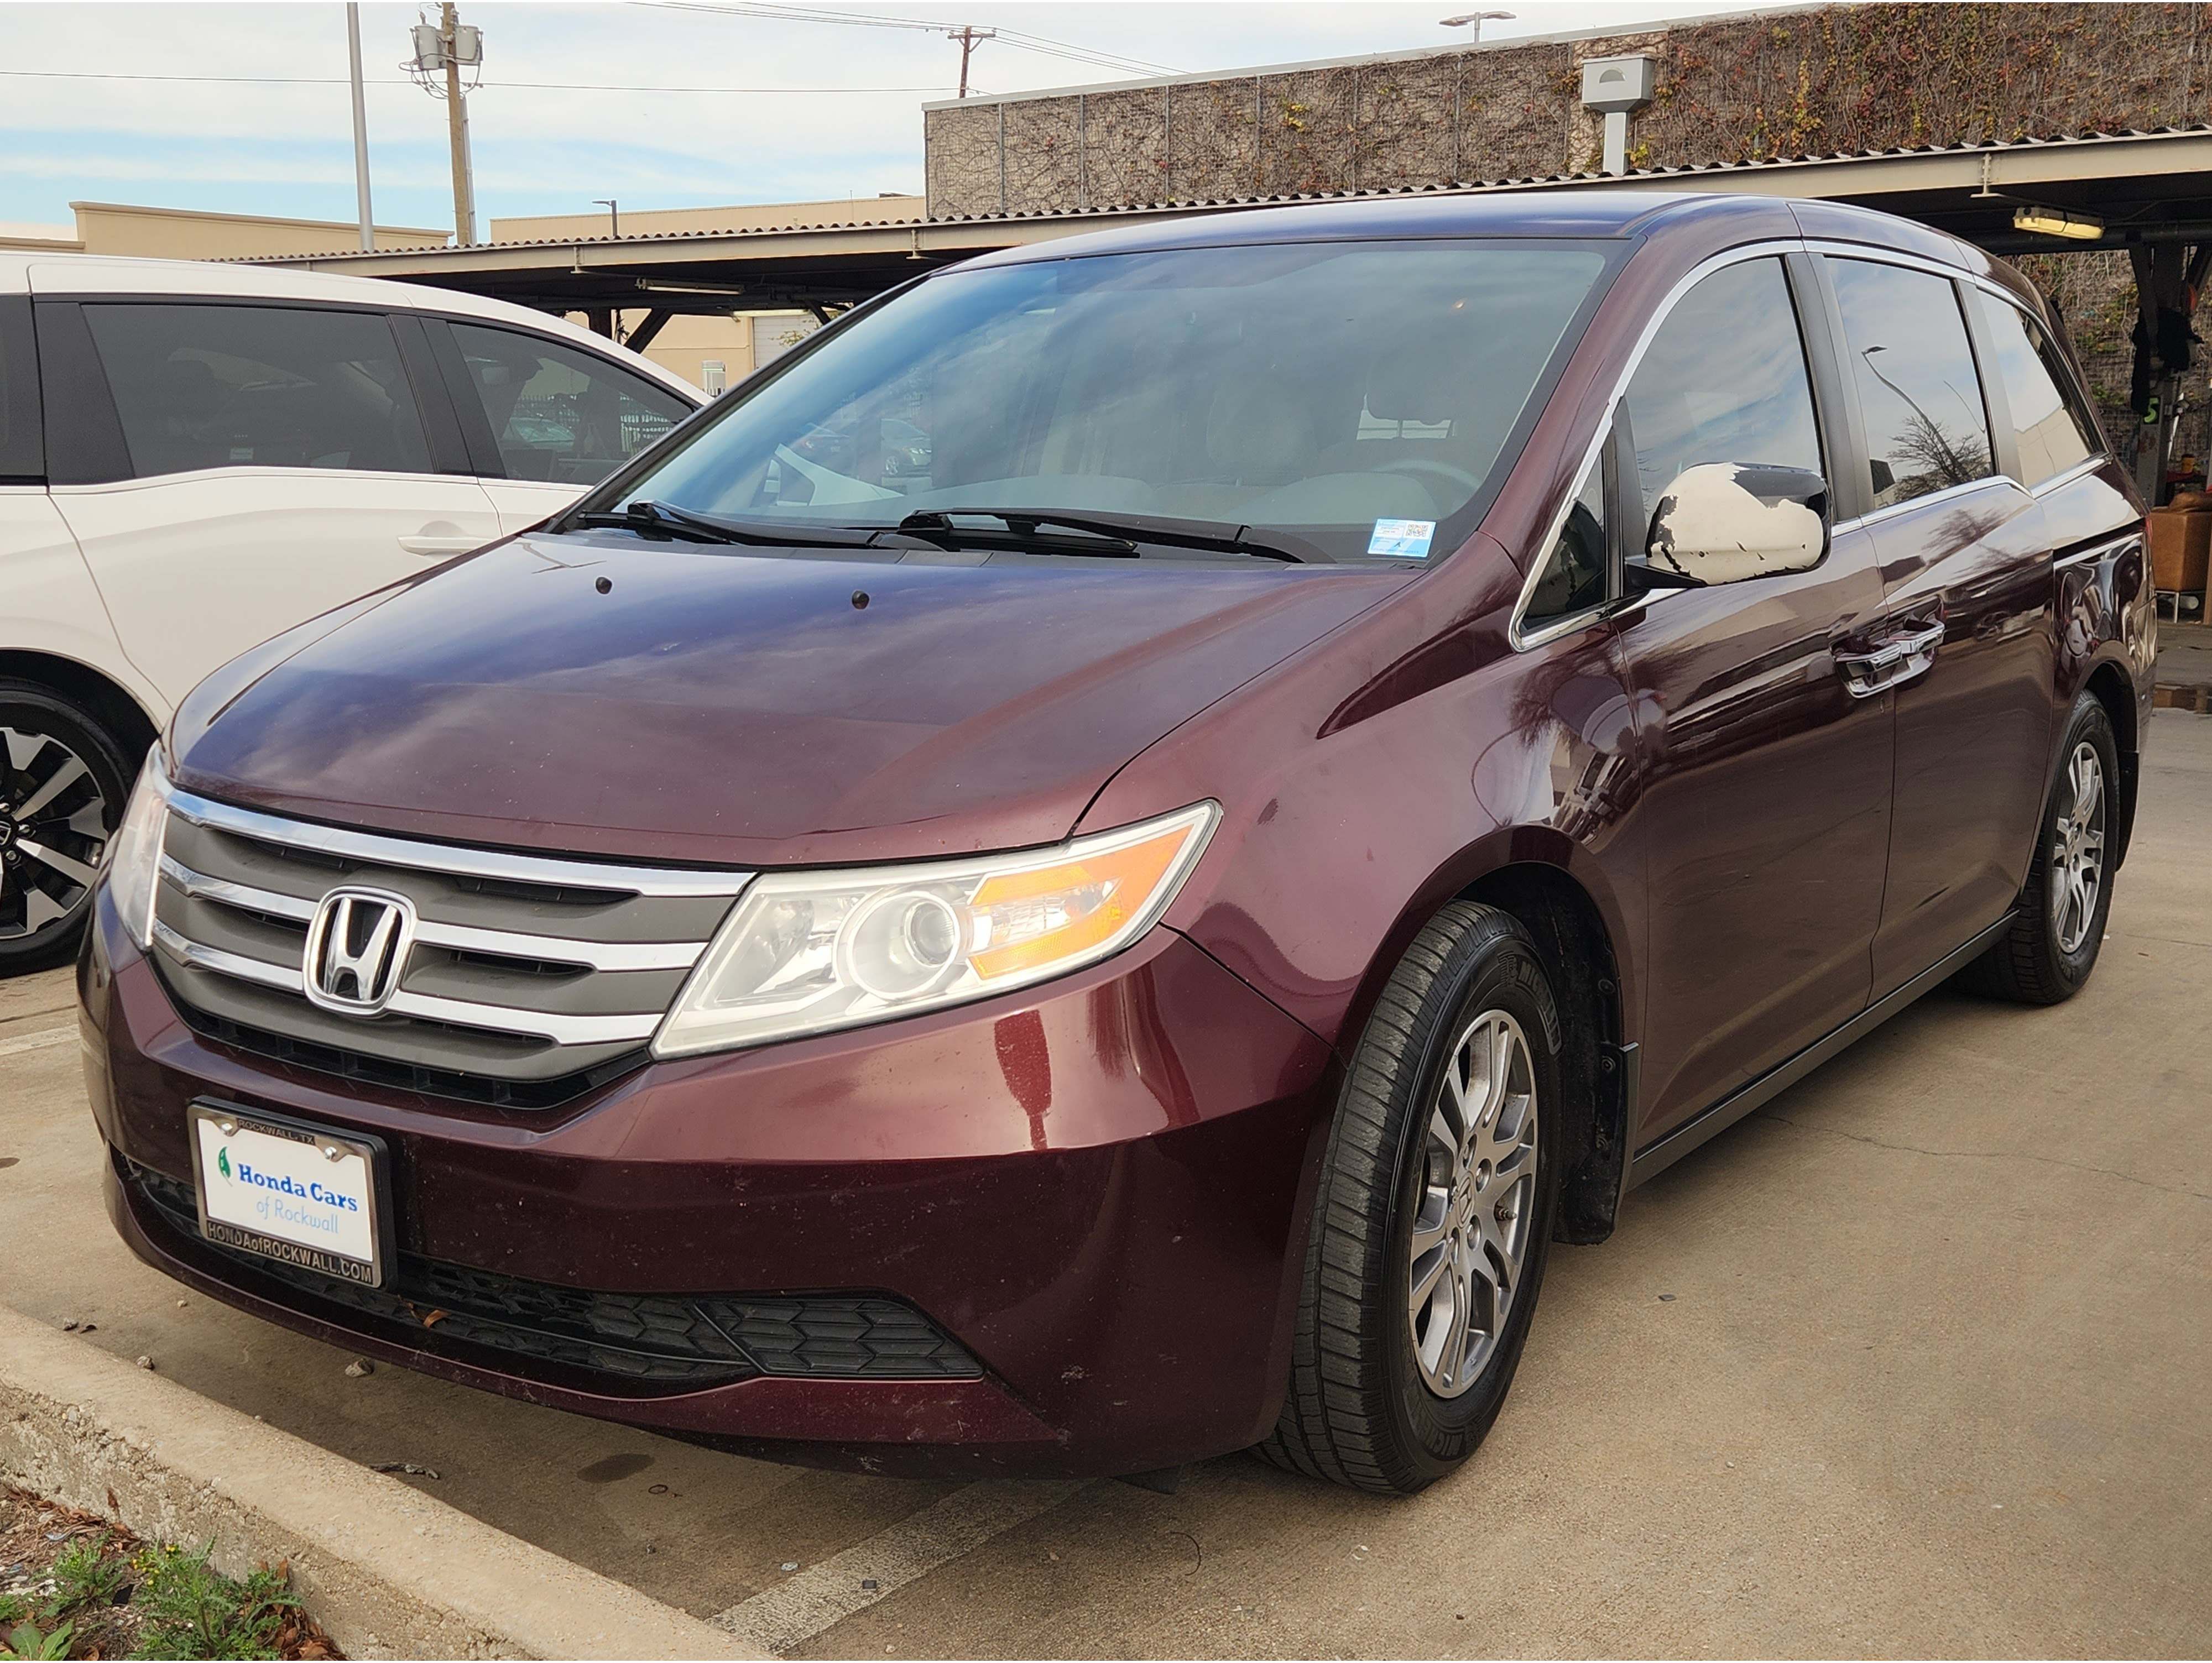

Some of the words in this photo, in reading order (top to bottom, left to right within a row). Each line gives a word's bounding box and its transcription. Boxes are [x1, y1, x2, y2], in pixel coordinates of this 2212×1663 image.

[2144, 398, 2159, 423] 5
[299, 1134, 314, 1144] TX
[238, 1163, 307, 1199] Honda
[310, 1182, 358, 1212] Cars
[256, 1196, 270, 1220] of
[274, 1199, 339, 1234] Rockwall
[207, 1222, 373, 1284] HONDAofROCKWALL.COM
